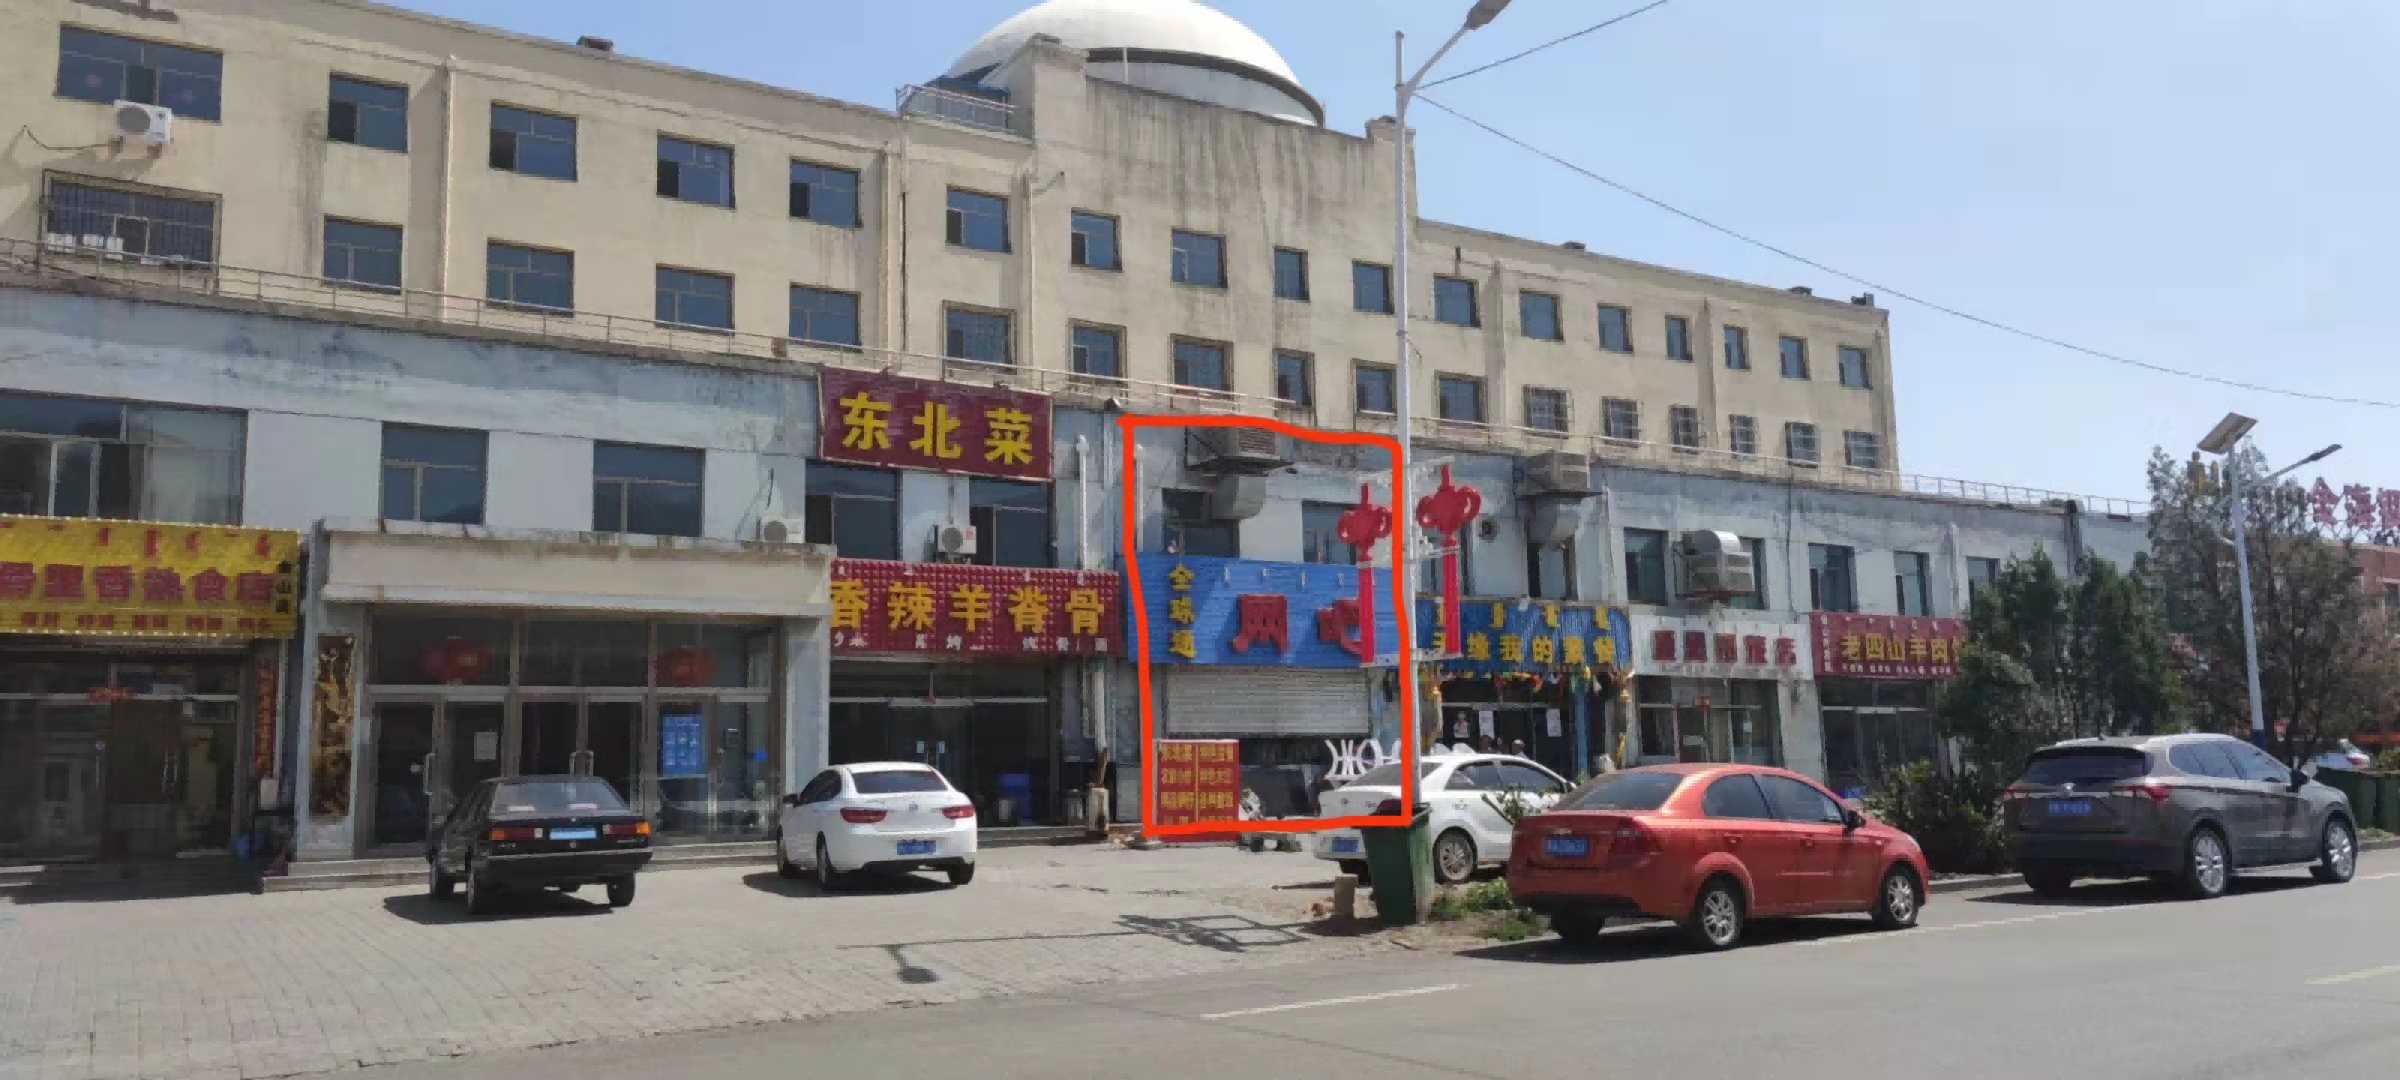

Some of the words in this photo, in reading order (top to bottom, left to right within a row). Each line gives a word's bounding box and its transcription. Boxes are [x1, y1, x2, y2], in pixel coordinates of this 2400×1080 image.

[840, 391, 1033, 465] 东北菜
[830, 578, 1105, 635] 香辣羊脊骨
[1168, 564, 1196, 658] 全球通
[1231, 593, 1364, 656] 网吧
